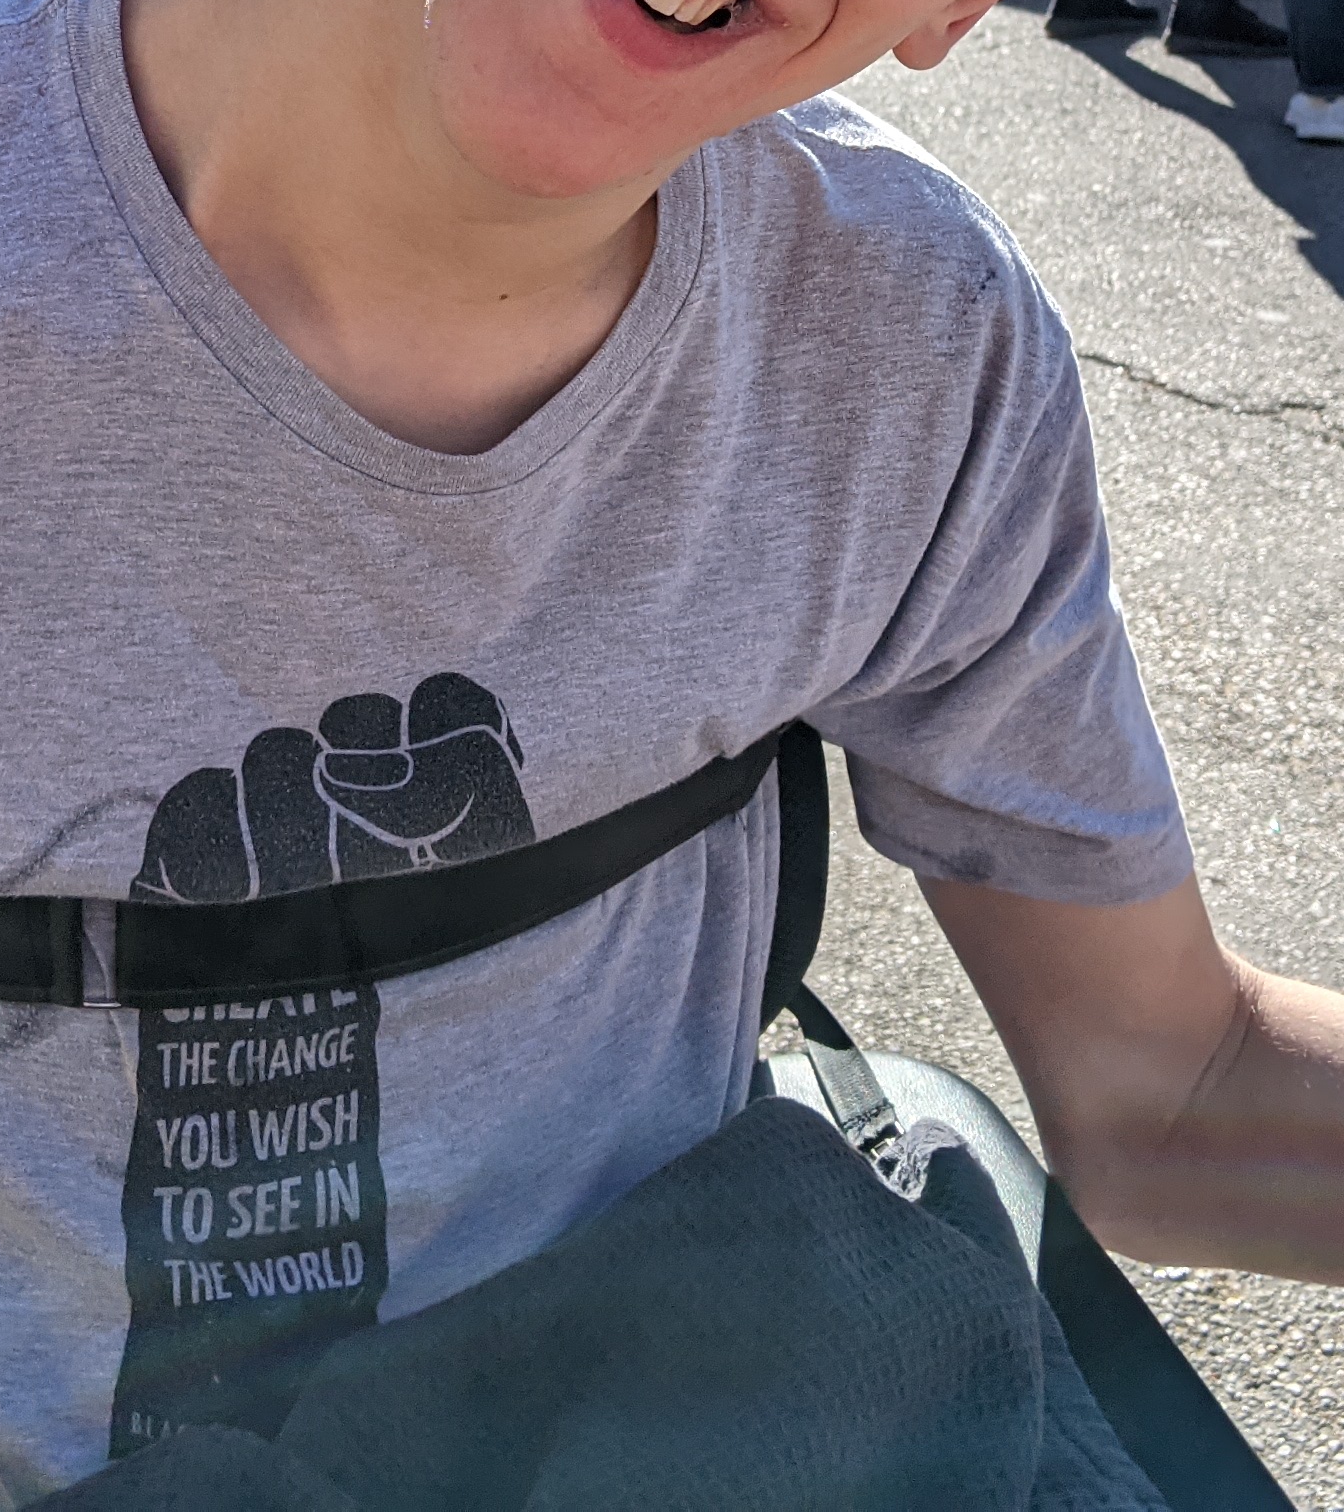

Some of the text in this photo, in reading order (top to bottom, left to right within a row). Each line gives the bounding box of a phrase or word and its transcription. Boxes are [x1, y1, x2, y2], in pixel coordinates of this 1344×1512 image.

[156, 1021, 360, 1089] THE CHANGE
[156, 1088, 359, 1171] YOU WISH
[153, 1160, 361, 1245] TO SEE IN
[163, 1240, 365, 1308] THE WORLD
